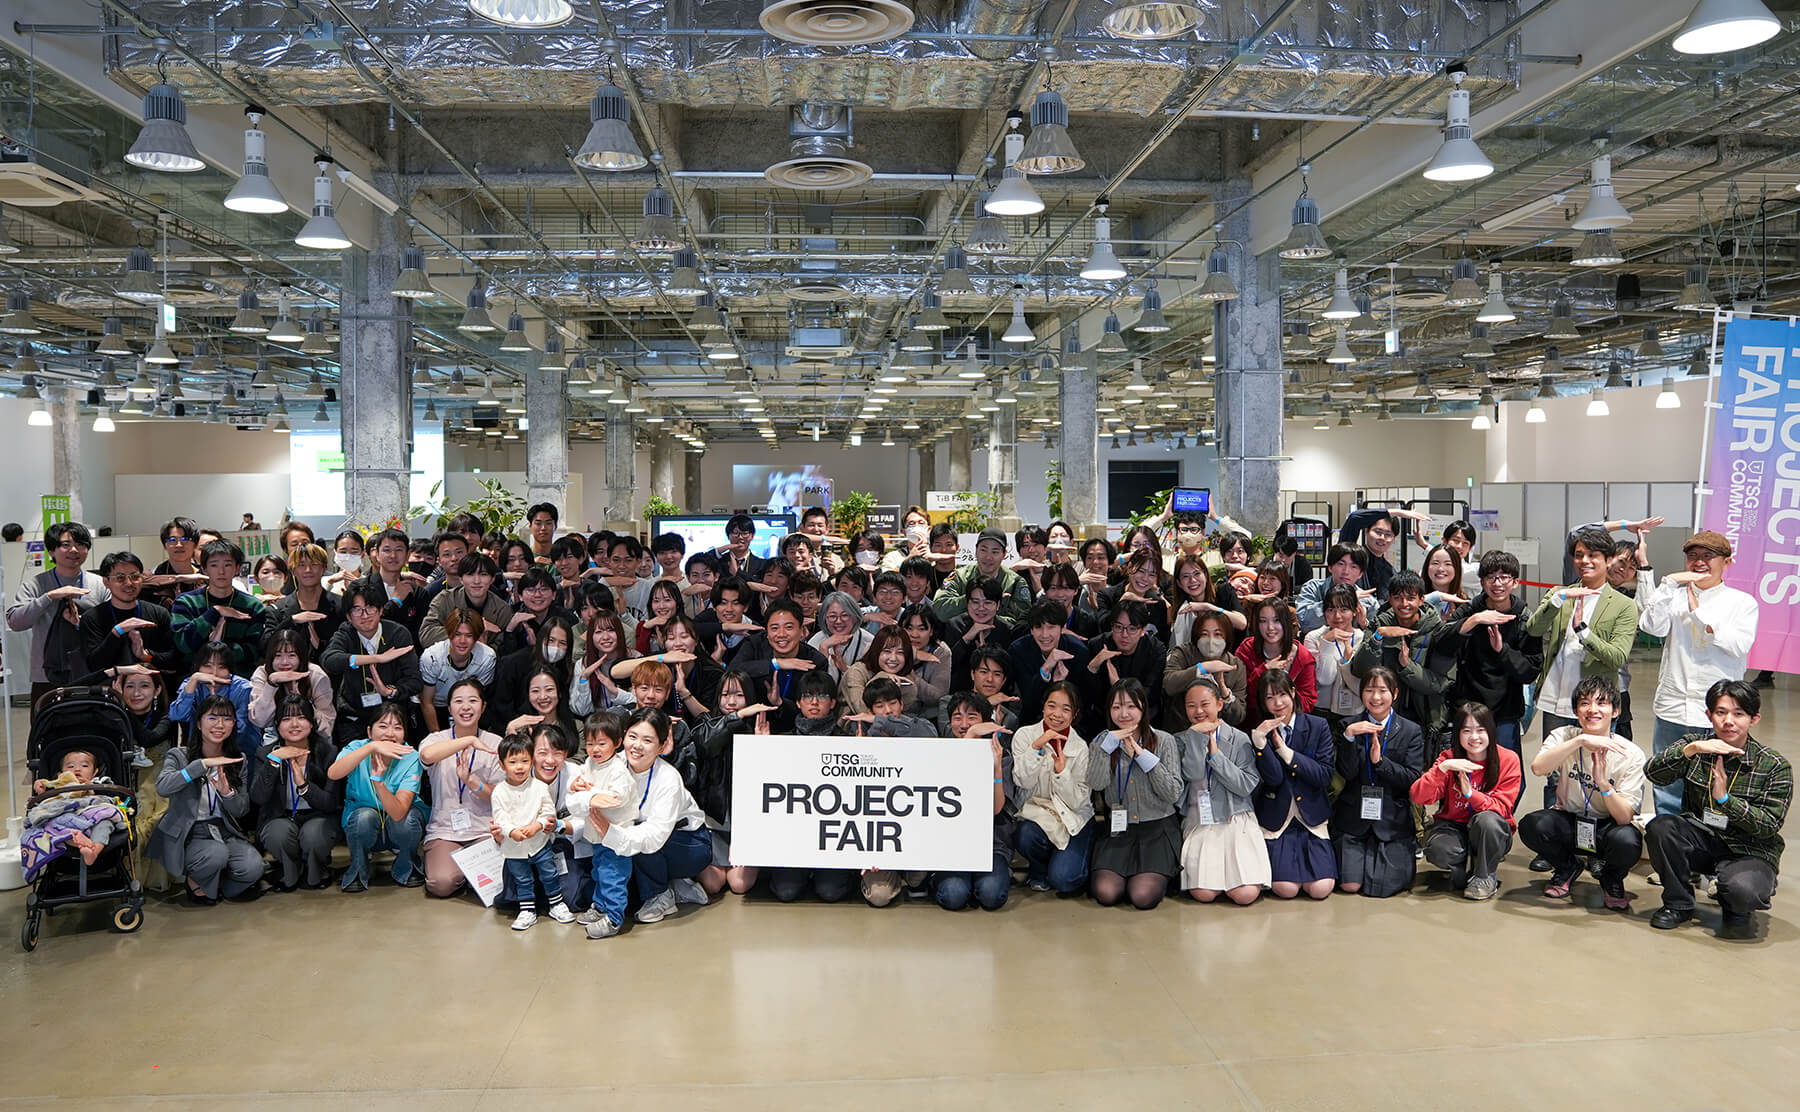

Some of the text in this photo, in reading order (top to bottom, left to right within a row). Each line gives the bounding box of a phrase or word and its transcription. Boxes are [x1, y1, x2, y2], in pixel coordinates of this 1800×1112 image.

[1729, 345, 1785, 453] FAIR
[804, 486, 830, 494] PARK
[1743, 476, 1762, 510] TSG
[821, 765, 903, 778] COMMUNITY
[833, 753, 860, 765] TSG
[762, 782, 962, 818] PROJECTS
[818, 819, 903, 852] FAIR
